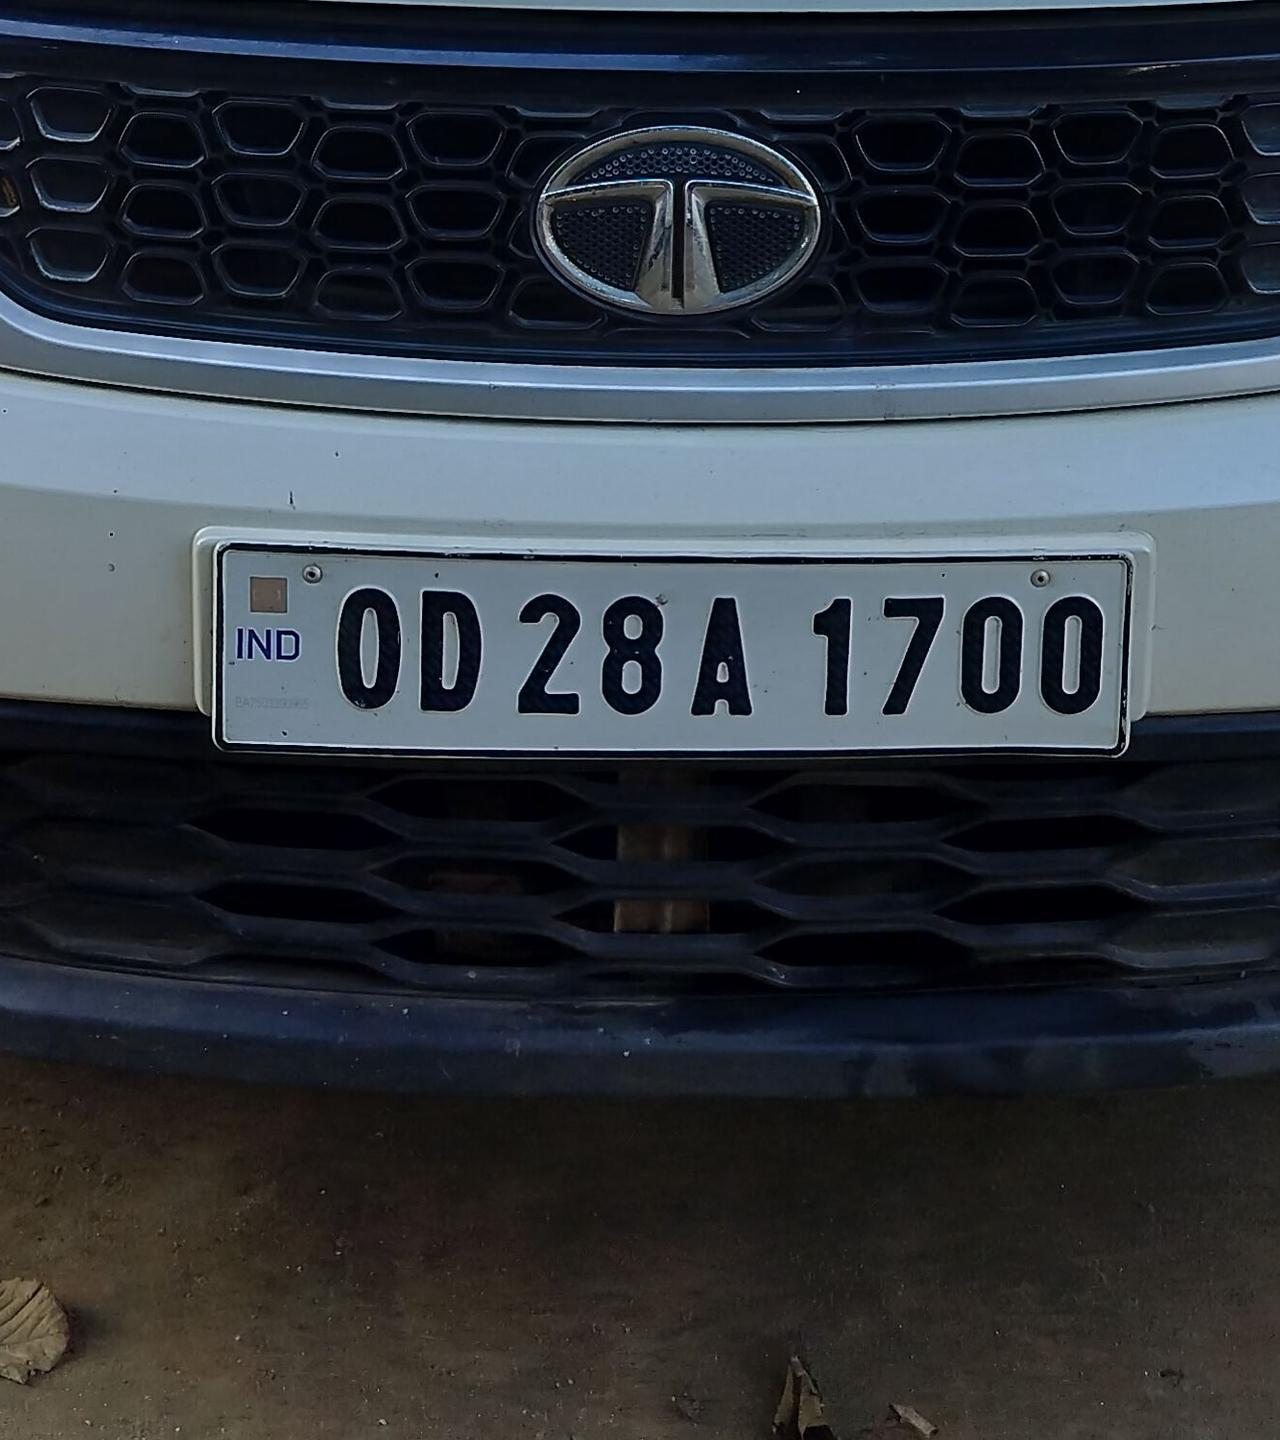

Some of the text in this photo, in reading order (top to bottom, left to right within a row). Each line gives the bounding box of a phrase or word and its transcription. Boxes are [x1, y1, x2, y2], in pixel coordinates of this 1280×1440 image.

[236, 628, 300, 661] IND
[338, 588, 1103, 715] OD 28 A 1700
